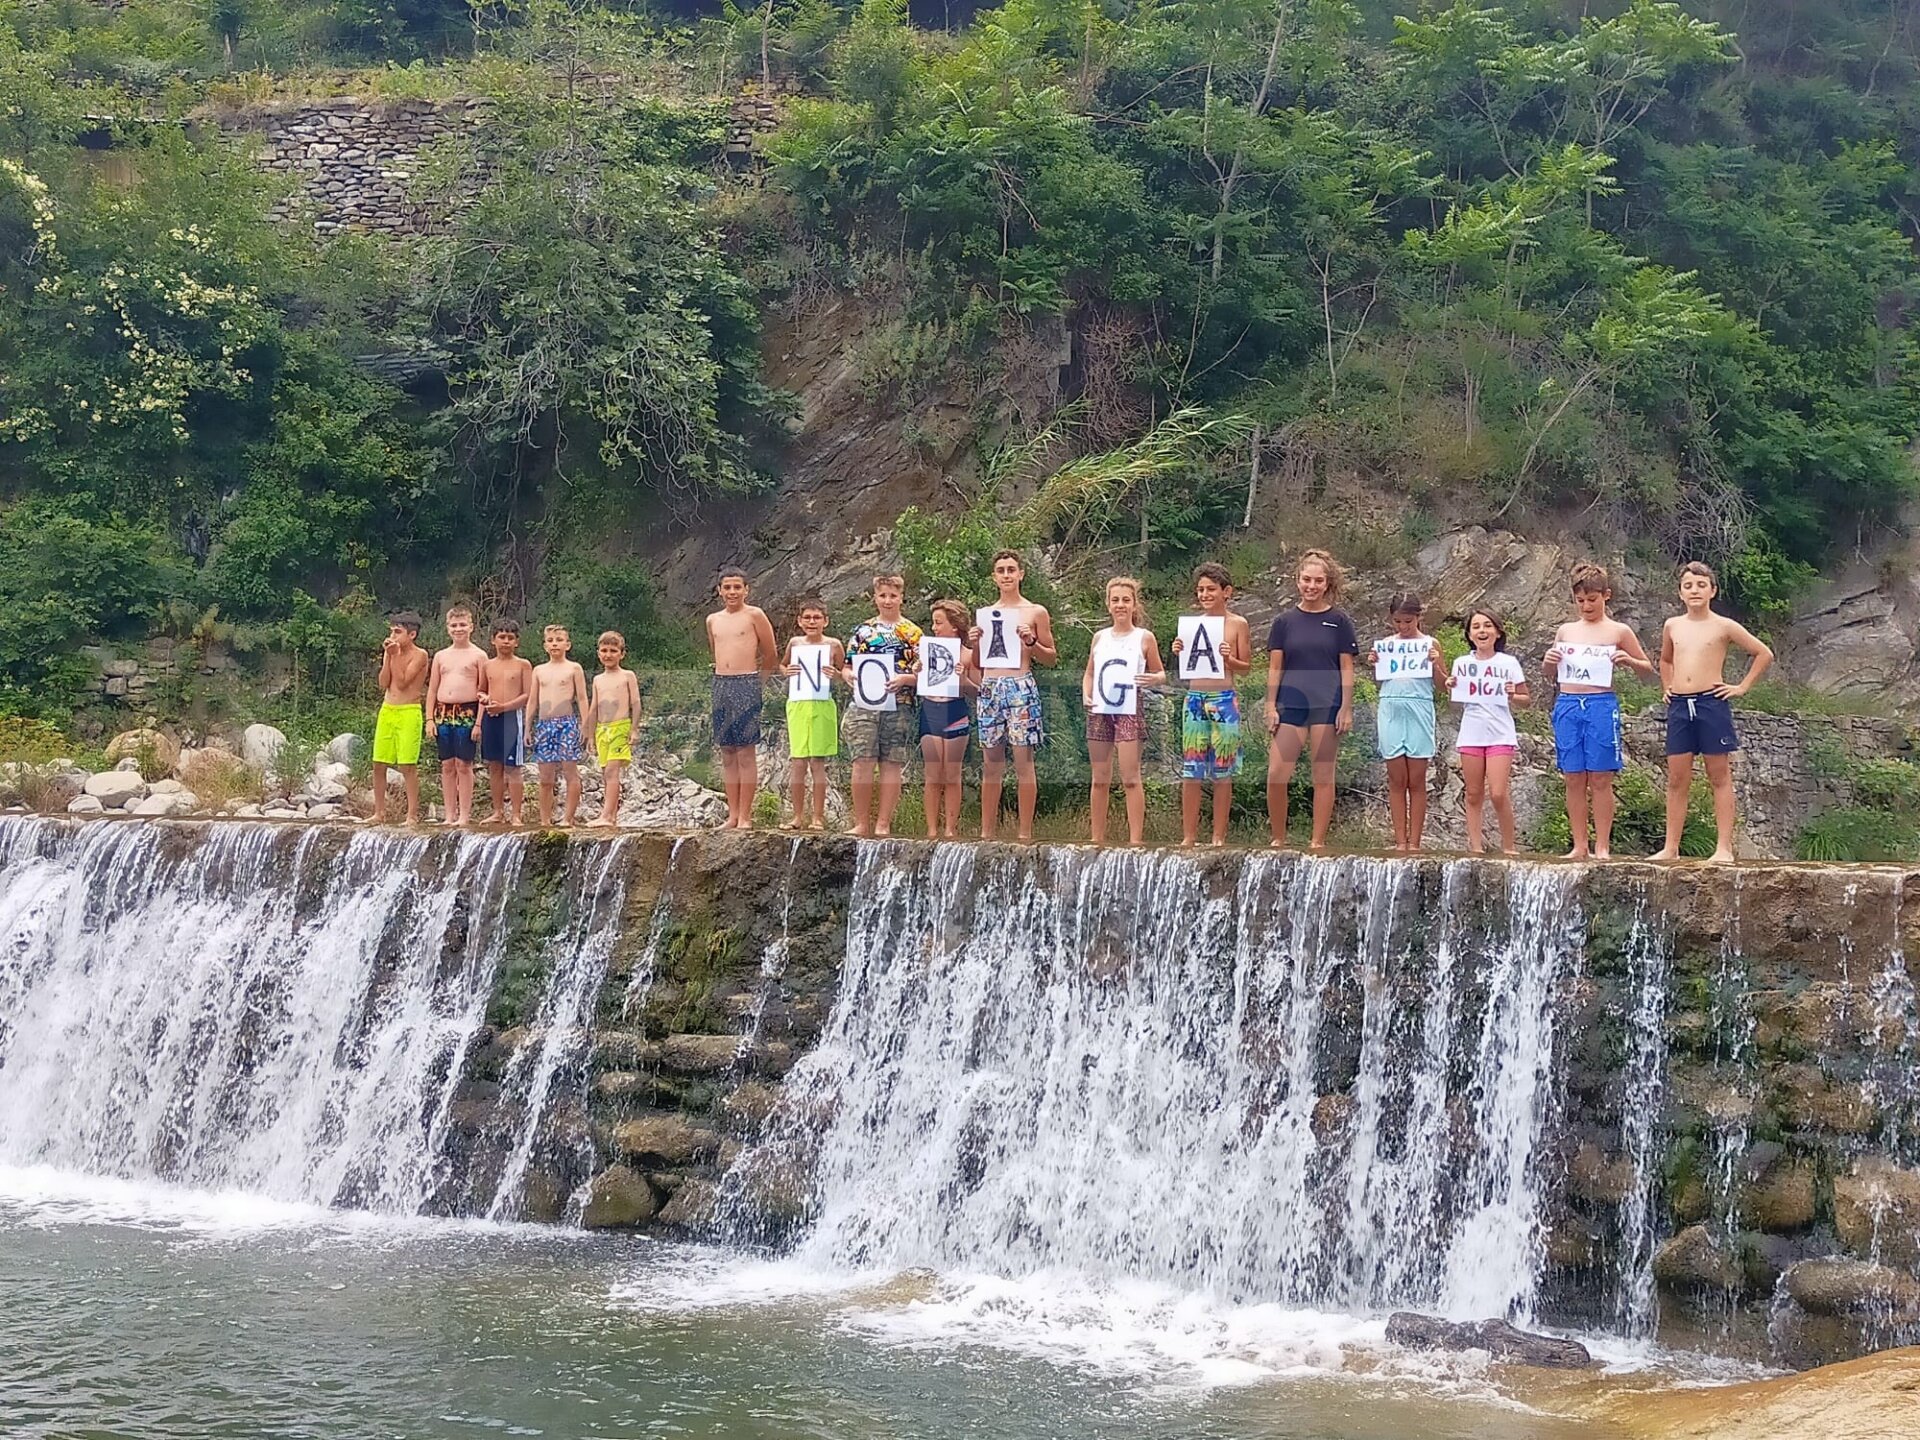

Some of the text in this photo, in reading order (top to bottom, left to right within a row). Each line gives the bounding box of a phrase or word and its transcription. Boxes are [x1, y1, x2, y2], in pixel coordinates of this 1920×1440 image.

[1377, 641, 1429, 654] NO ALLA
[1457, 663, 1478, 677] NO
